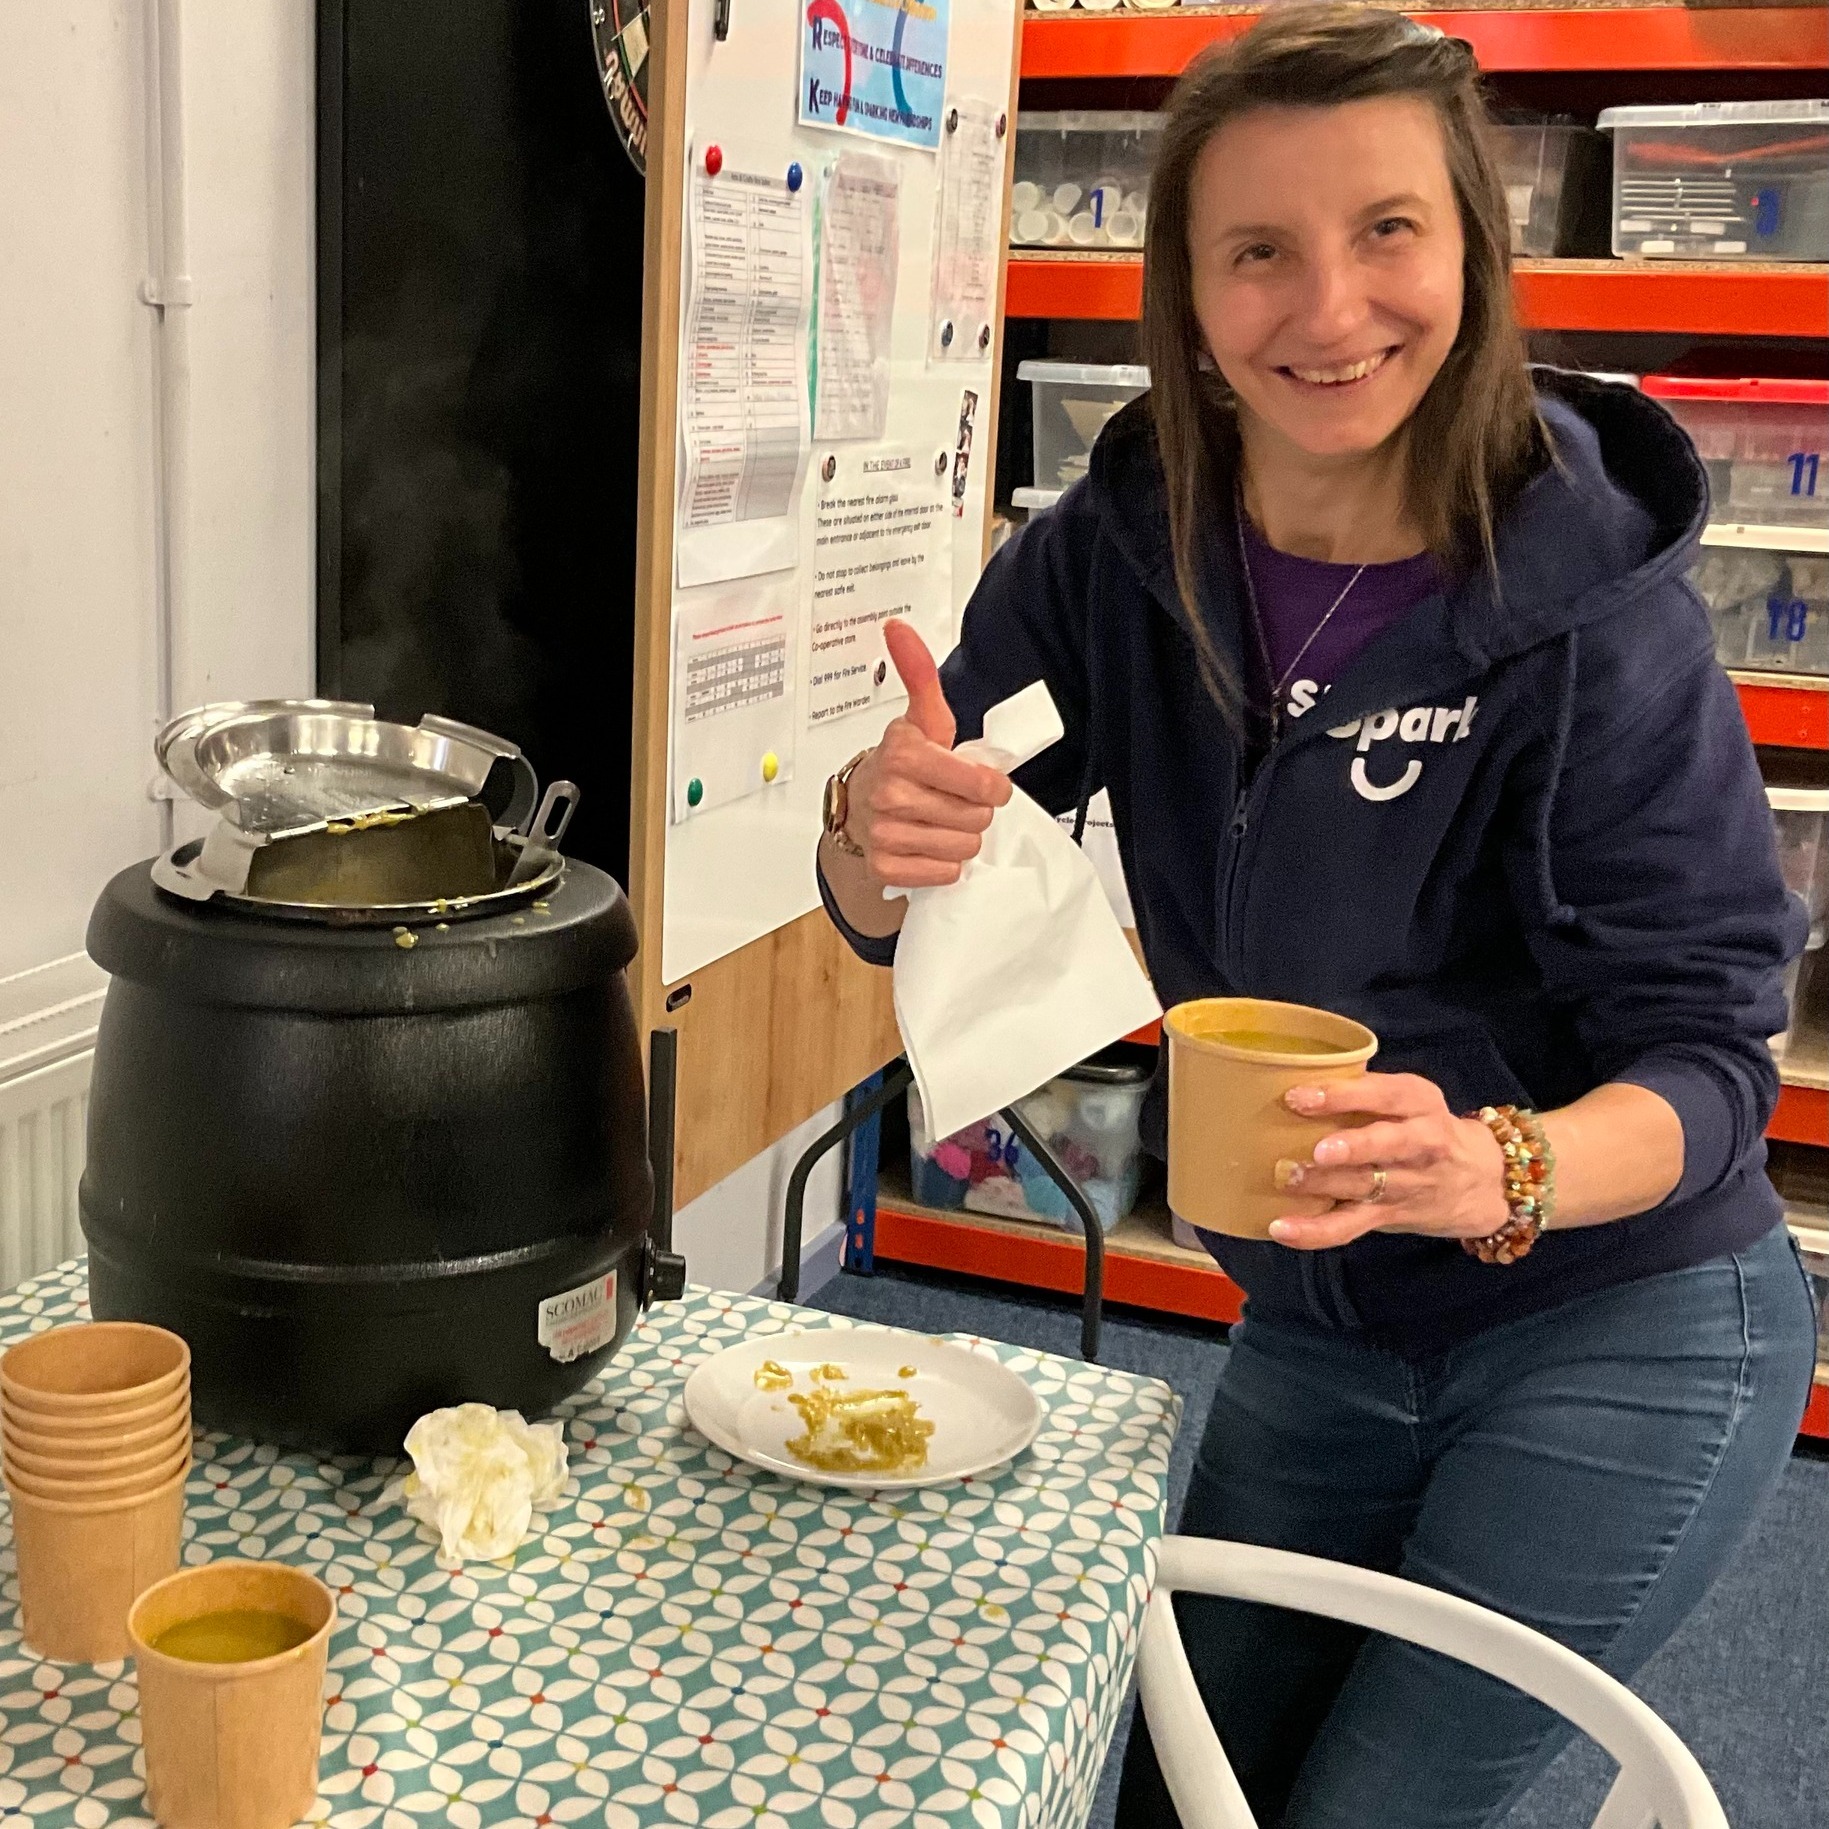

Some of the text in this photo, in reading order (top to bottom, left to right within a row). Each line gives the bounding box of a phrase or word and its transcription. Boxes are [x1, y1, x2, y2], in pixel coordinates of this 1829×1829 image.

[808, 77, 833, 115] KEEP
[1089, 188, 1104, 228] 1
[1787, 452, 1820, 496] 11
